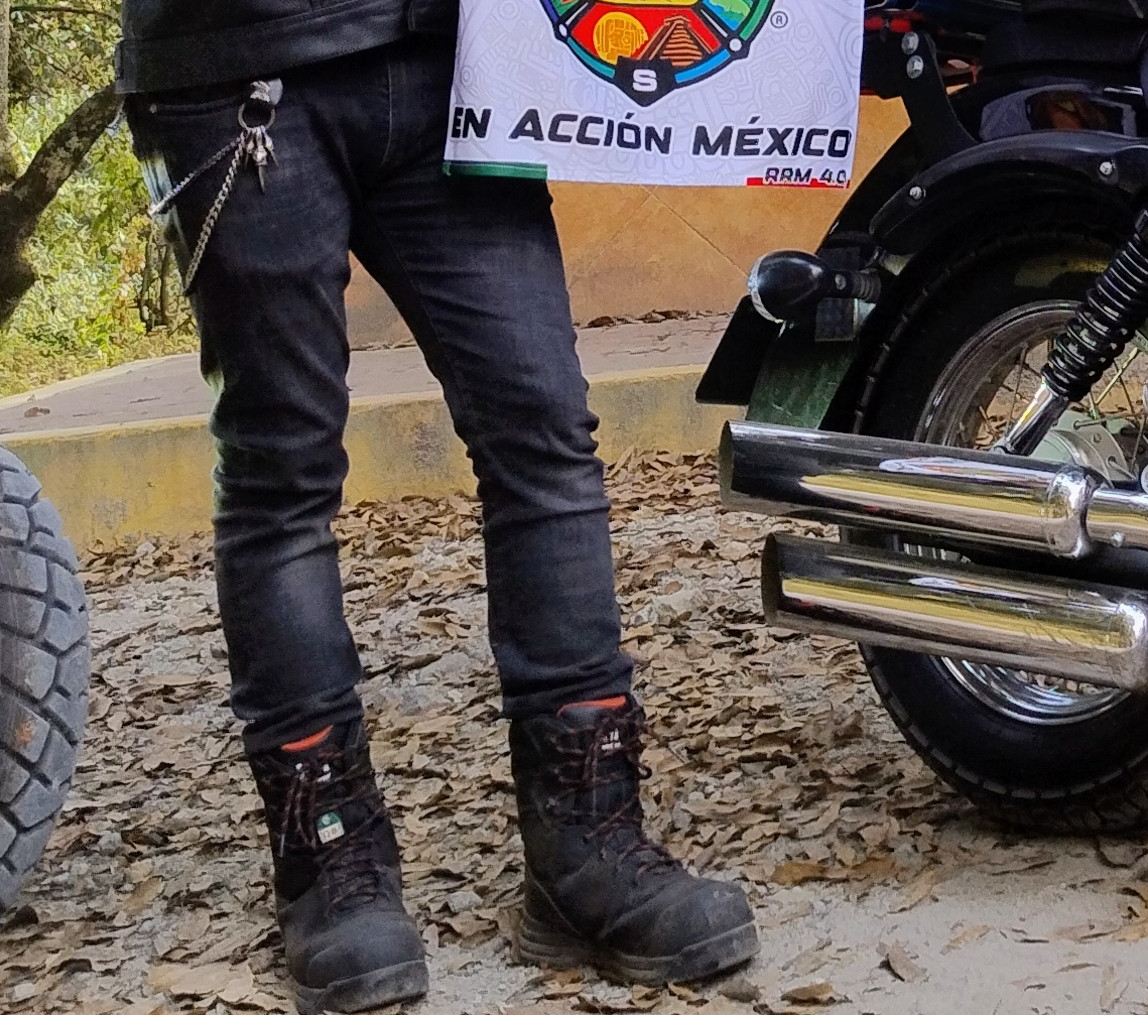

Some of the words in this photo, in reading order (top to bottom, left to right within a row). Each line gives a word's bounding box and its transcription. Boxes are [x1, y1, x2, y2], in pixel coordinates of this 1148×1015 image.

[632, 68, 659, 92] S
[451, 106, 492, 139] EN
[508, 108, 672, 154] ACCIÓN
[692, 115, 851, 157] MÉXICO
